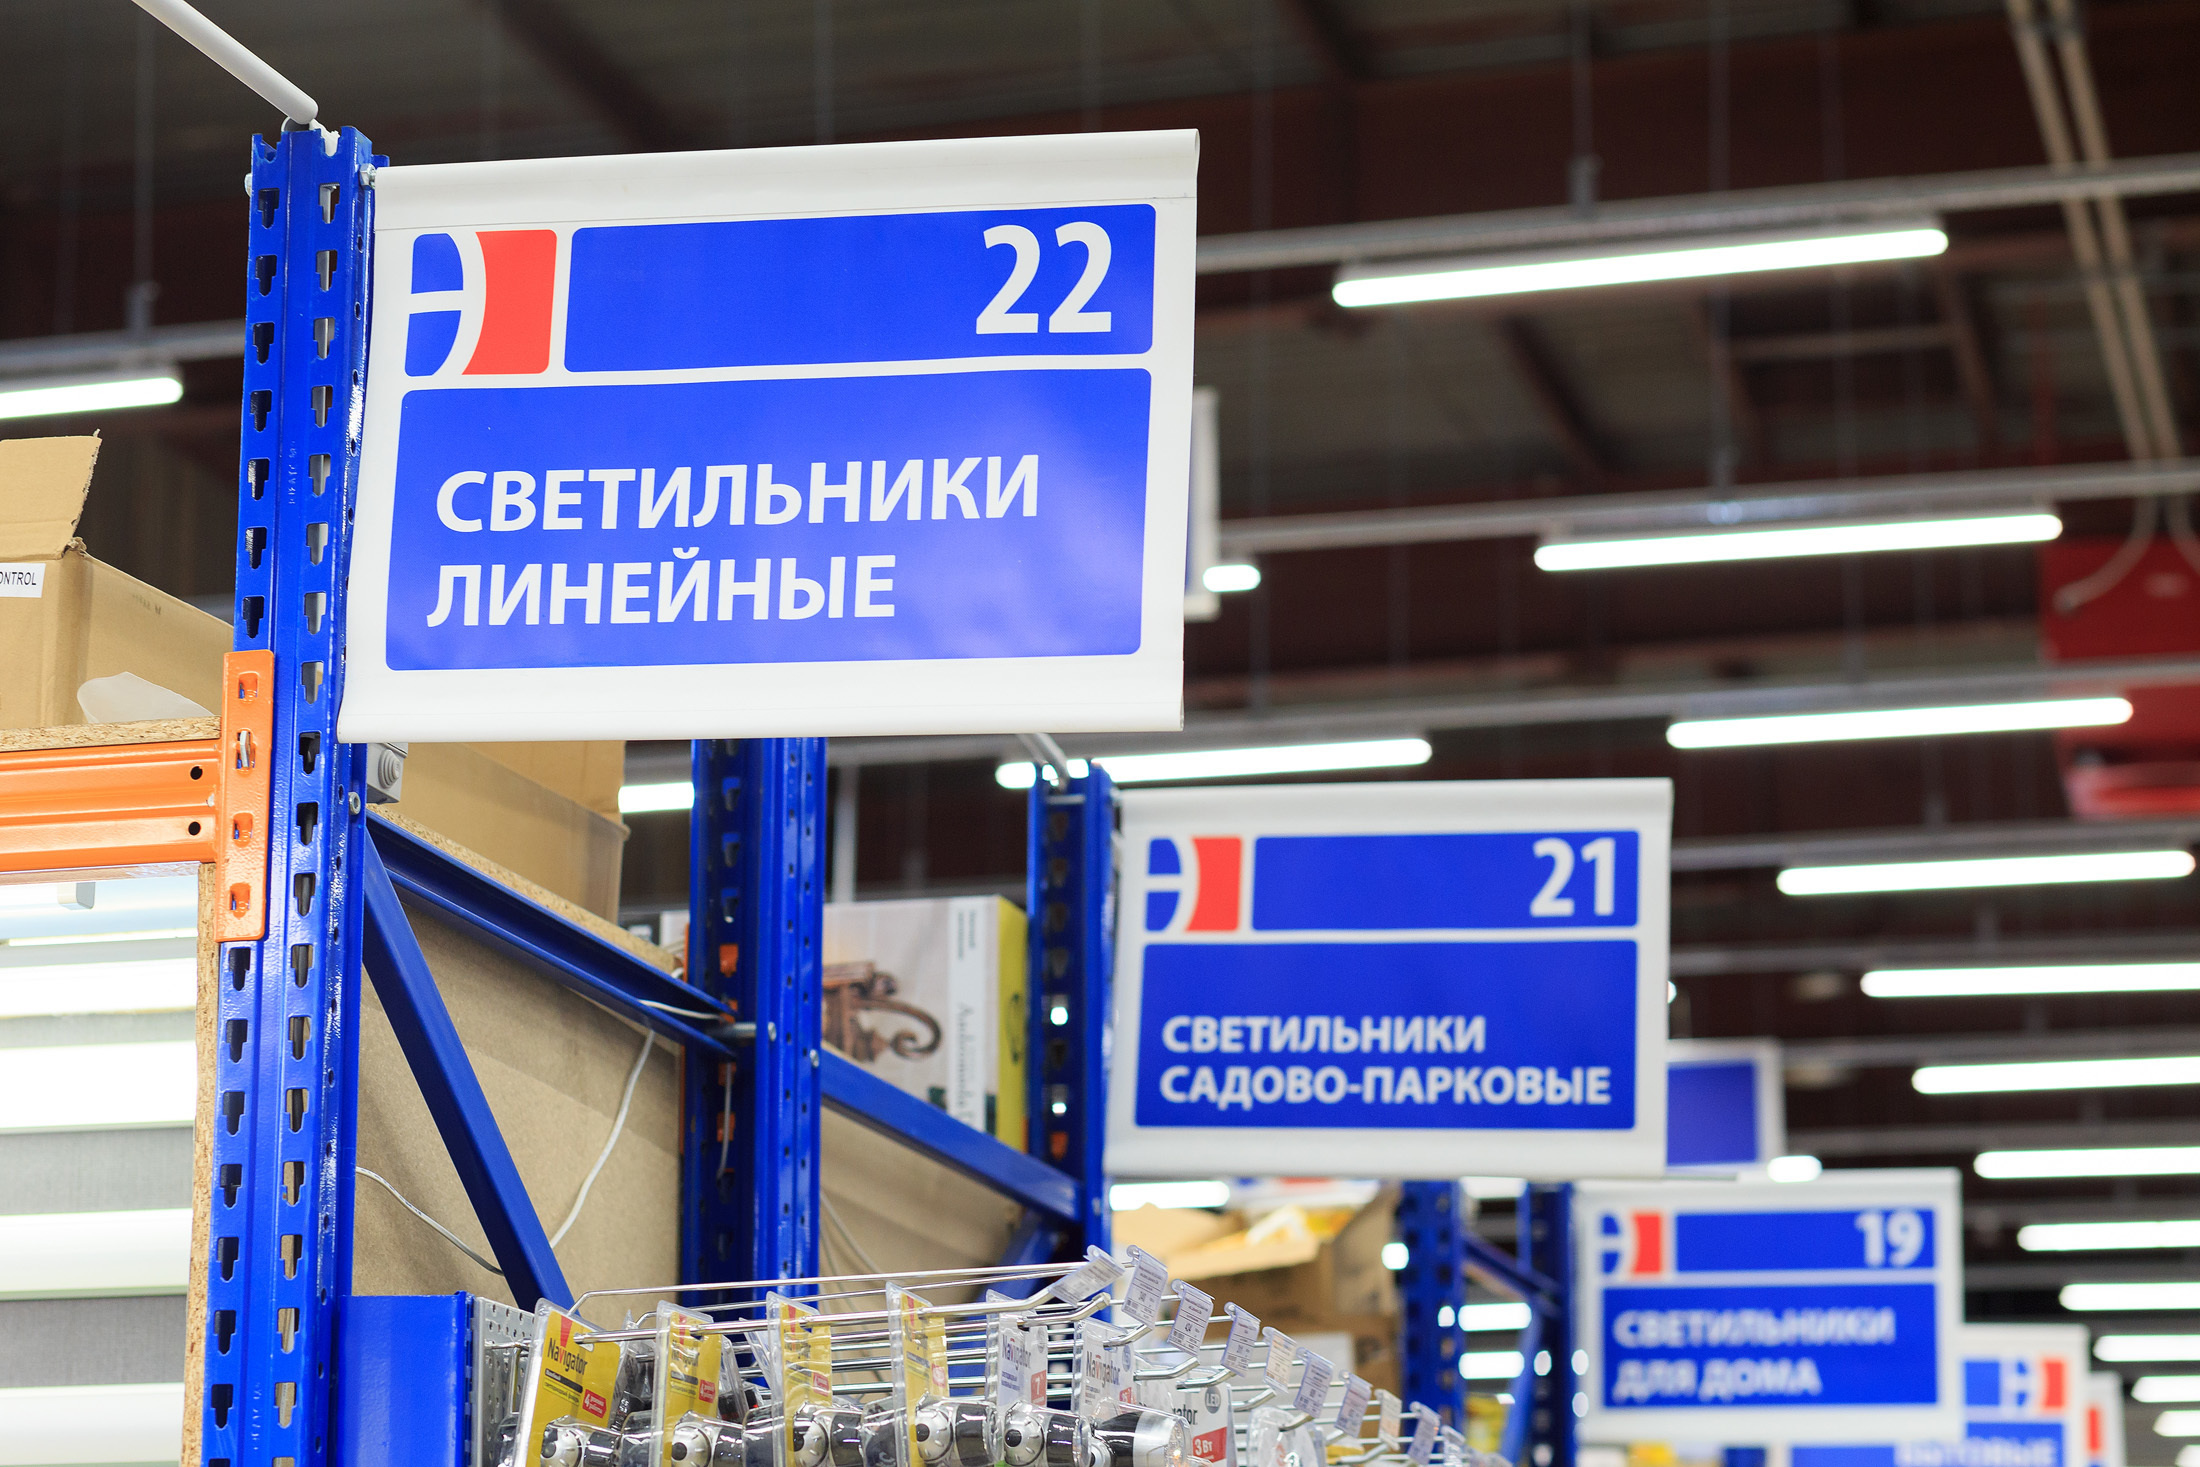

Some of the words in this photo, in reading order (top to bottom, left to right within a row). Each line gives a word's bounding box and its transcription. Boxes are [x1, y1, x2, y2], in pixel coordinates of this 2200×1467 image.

[975, 221, 1113, 335] 22
[435, 453, 1040, 534] СВЕТИЛЬНИКИ
[426, 546, 896, 629] ЛИНЕЙНЫЕ
[1530, 838, 1616, 917] 21
[1162, 1015, 1486, 1053] СВЕТИЛЬНИКИ
[1160, 1065, 1612, 1111] САДОВО-ПАРКОВЫЕ
[1853, 1207, 1926, 1268] 19
[1612, 1306, 1897, 1349] СВЕТИЛЬНИКИ
[547, 1337, 588, 1377] Navigator
[1002, 1334, 1032, 1371] Navigator
[1086, 1350, 1121, 1388] Navigator
[1206, 1392, 1219, 1408] LED
[1612, 1358, 1698, 1403] ДЛЯ
[1699, 1357, 1824, 1402] ДОМА
[1194, 1438, 1203, 1457] 3
